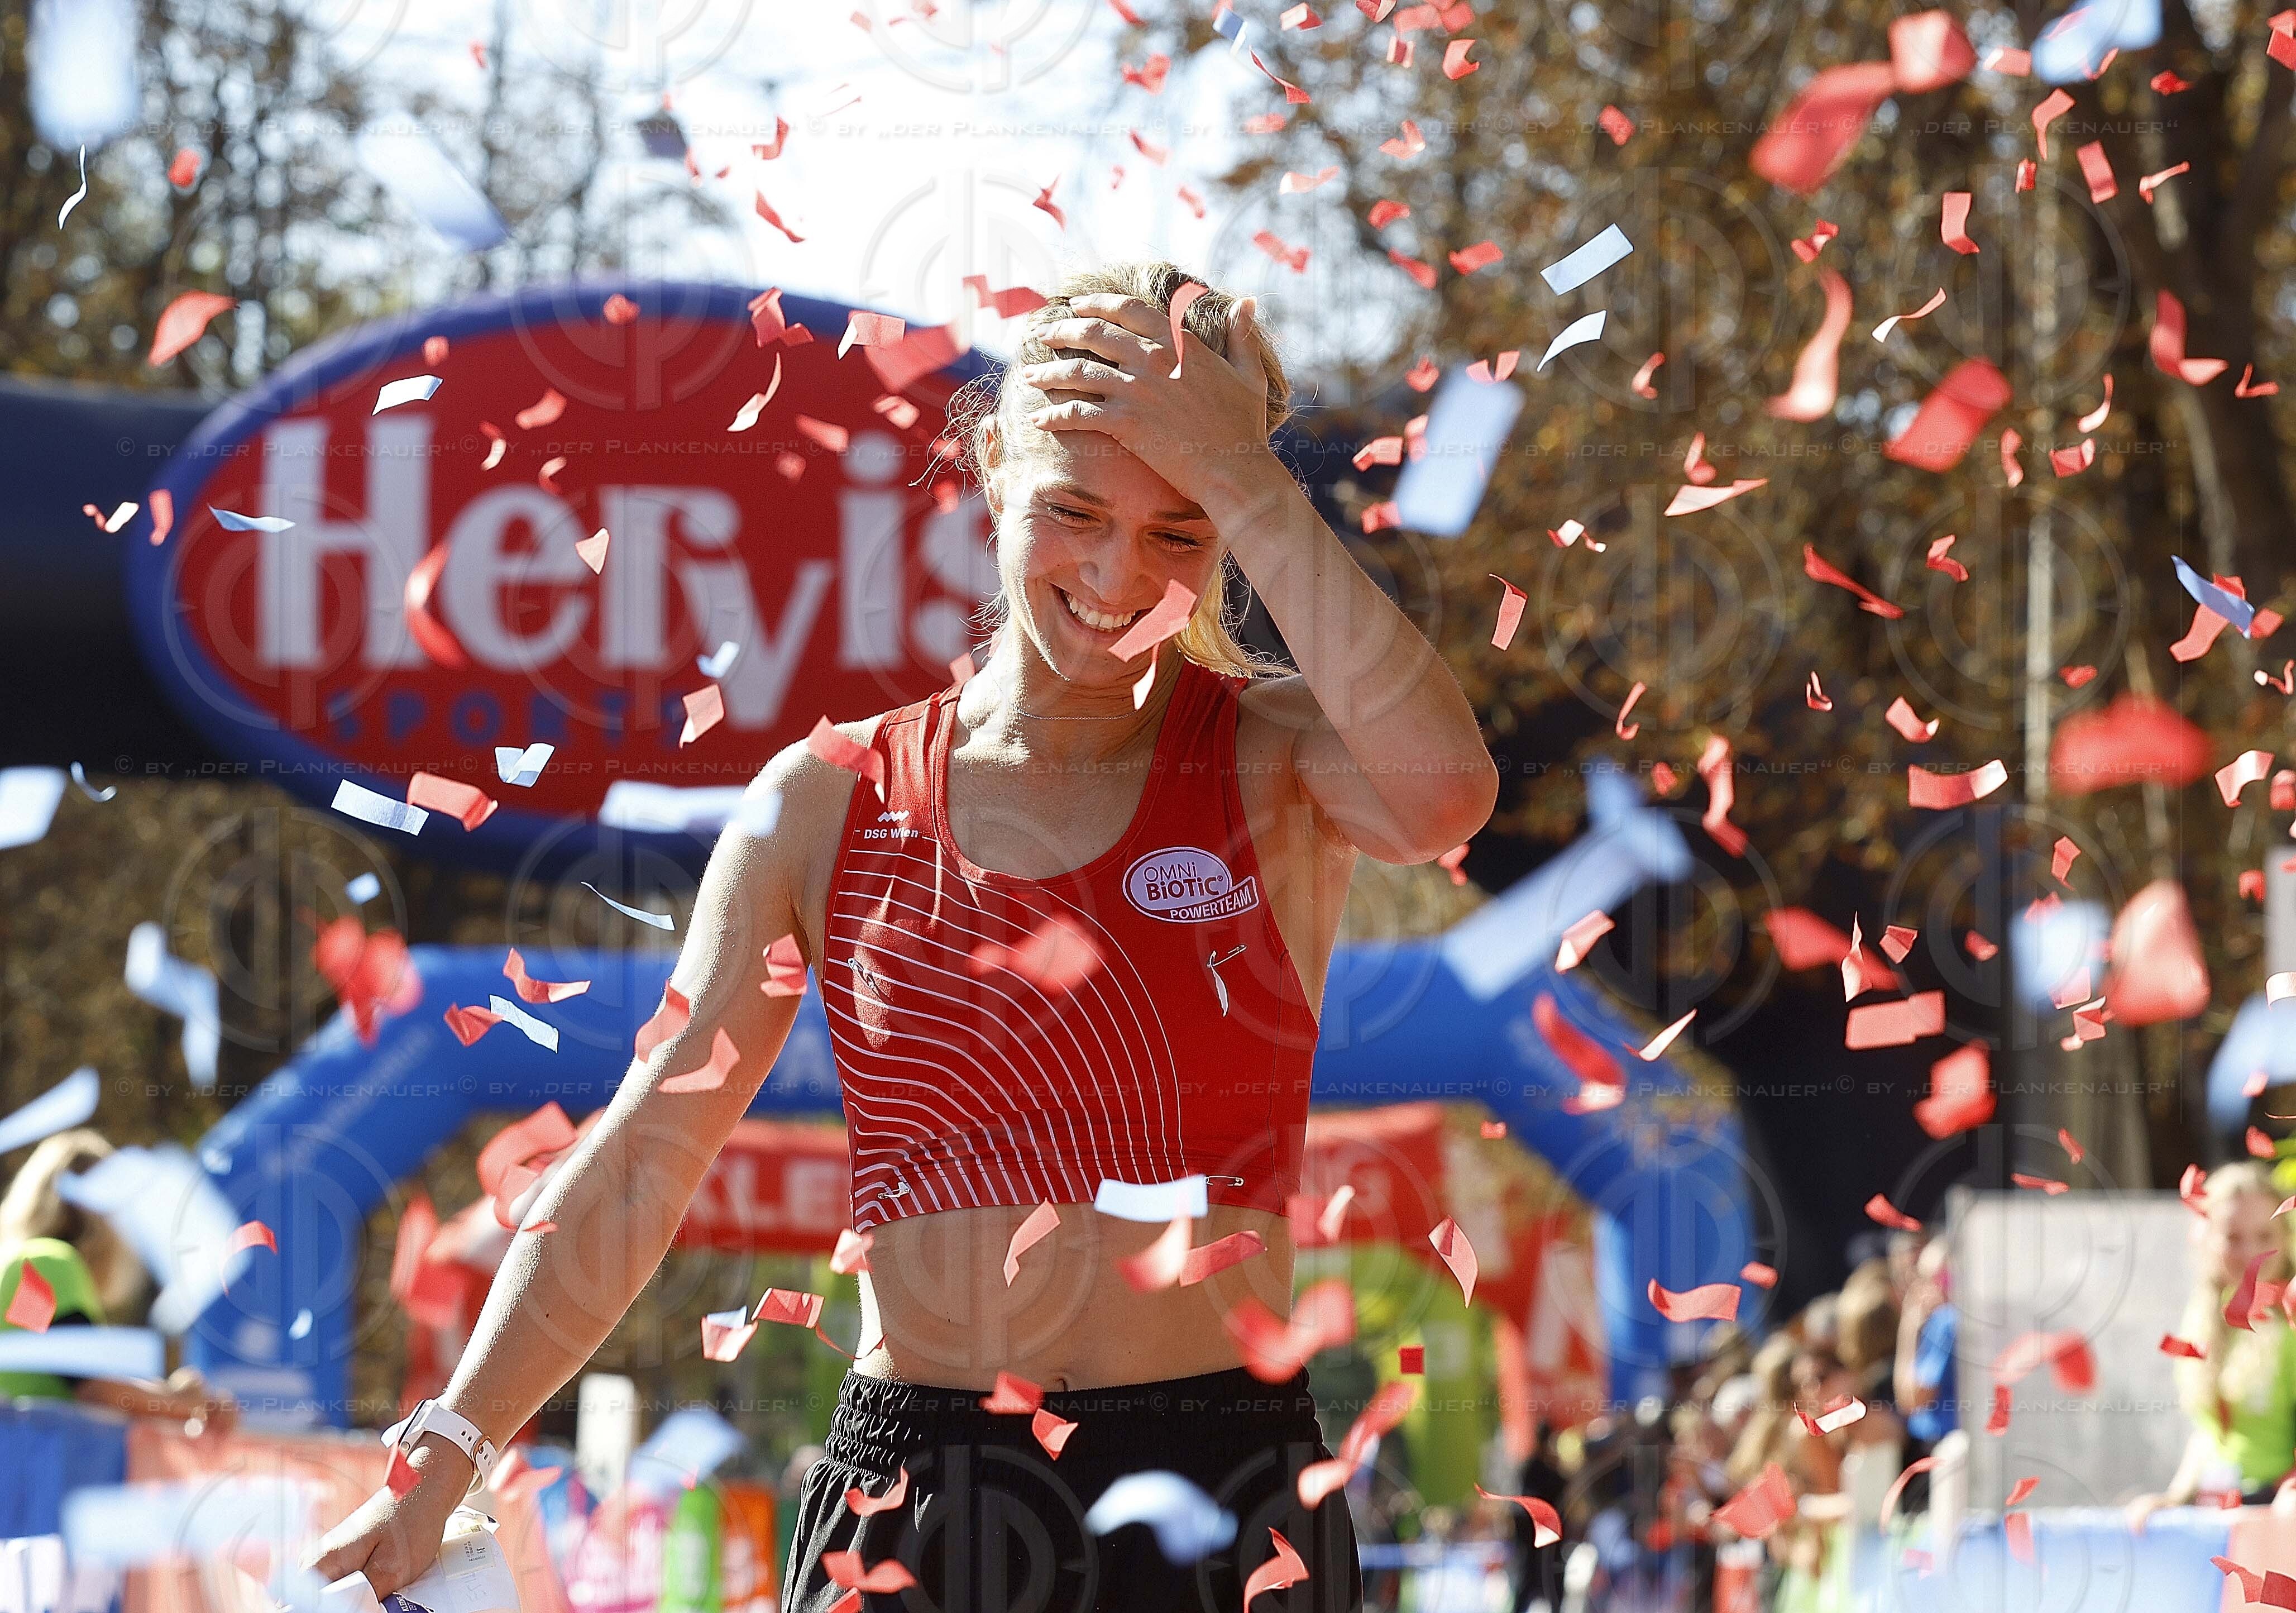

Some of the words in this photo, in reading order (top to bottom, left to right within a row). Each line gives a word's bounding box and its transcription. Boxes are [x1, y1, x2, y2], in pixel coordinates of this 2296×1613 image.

[258, 414, 1001, 729] Hervis
[864, 829, 887, 839] DSG
[891, 827, 919, 838] Wien
[1144, 862, 1197, 882] OMNi
[1170, 884, 1252, 919] POWERTEAM
